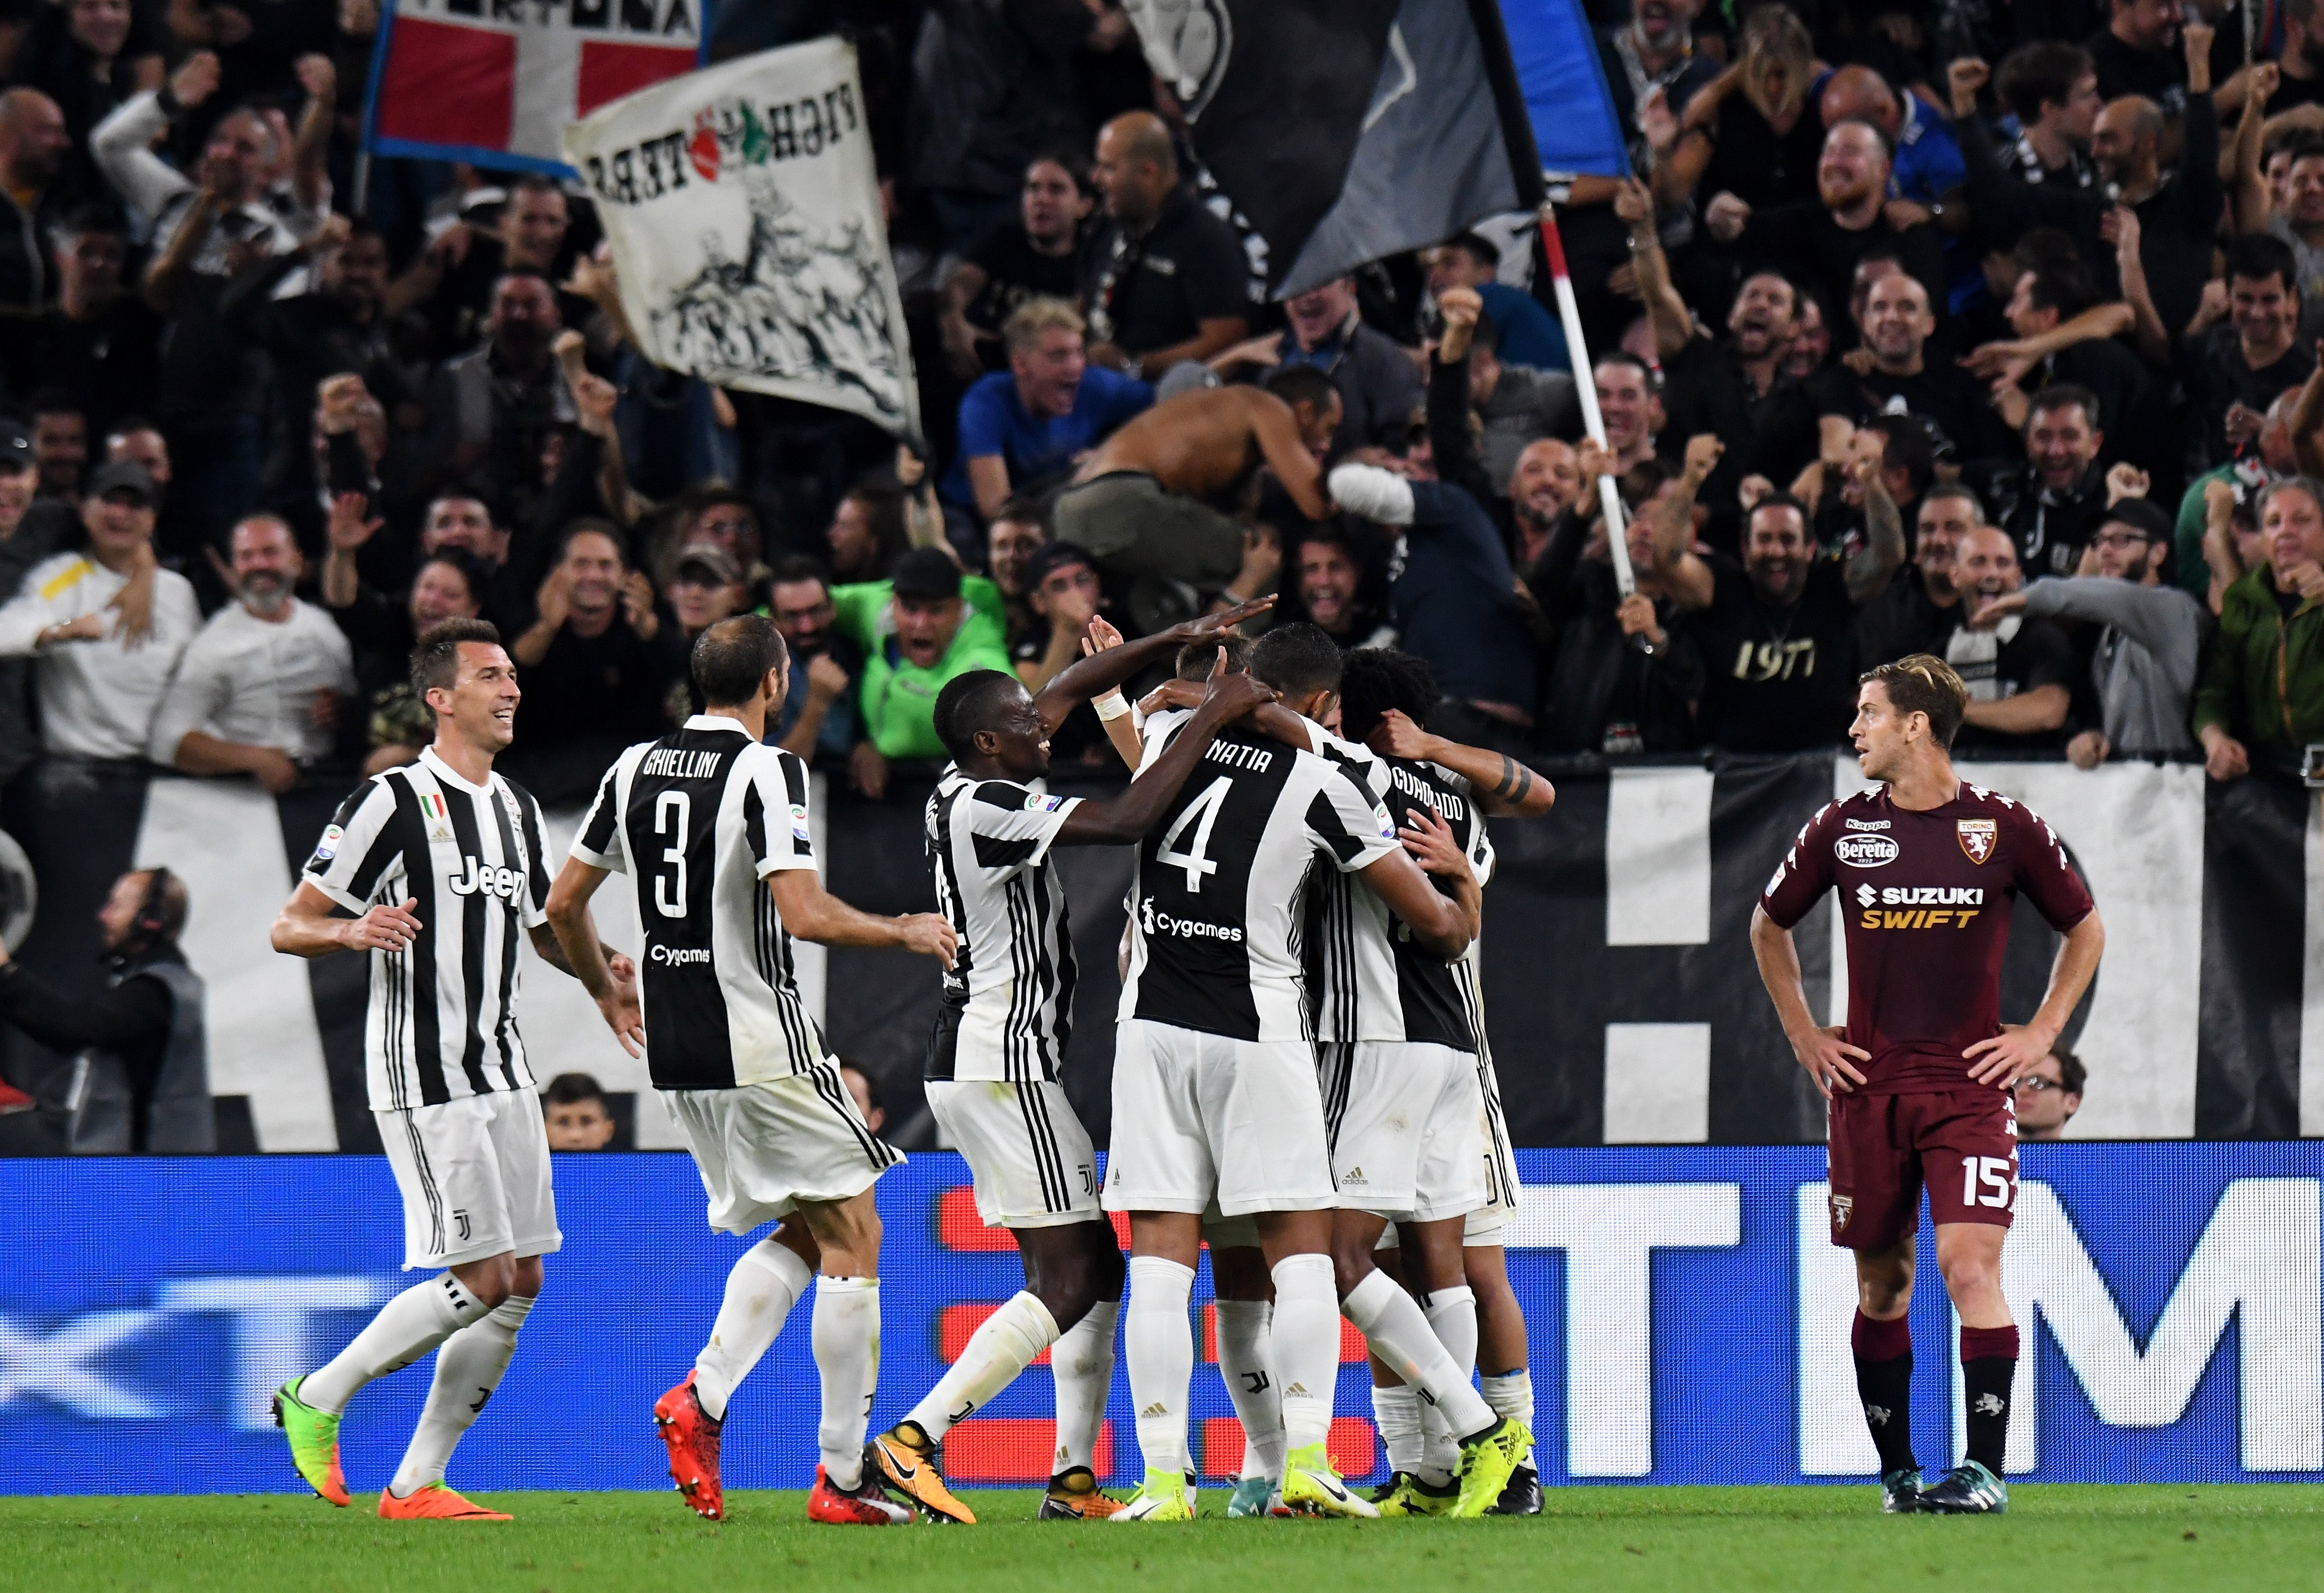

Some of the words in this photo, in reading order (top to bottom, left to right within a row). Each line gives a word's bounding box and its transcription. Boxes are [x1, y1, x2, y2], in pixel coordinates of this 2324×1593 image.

[1734, 639, 1815, 682] 1977
[643, 750, 721, 778] CHIELLINI
[1204, 739, 1273, 773] NATIA
[1157, 776, 1233, 893] 4
[1846, 818, 1891, 831] Kappa
[655, 791, 690, 918] 3
[1838, 841, 1896, 859] Beretta
[449, 855, 526, 906] Jeep
[1882, 887, 1984, 905] SUZUKI
[1157, 913, 1242, 942] Cygames
[1861, 910, 1979, 929] SWIFT
[651, 944, 710, 967] Cygames
[1961, 1155, 2010, 1208] 15
[1501, 1180, 2322, 1477] TIM
[1507, 1431, 1516, 1467] adidas
